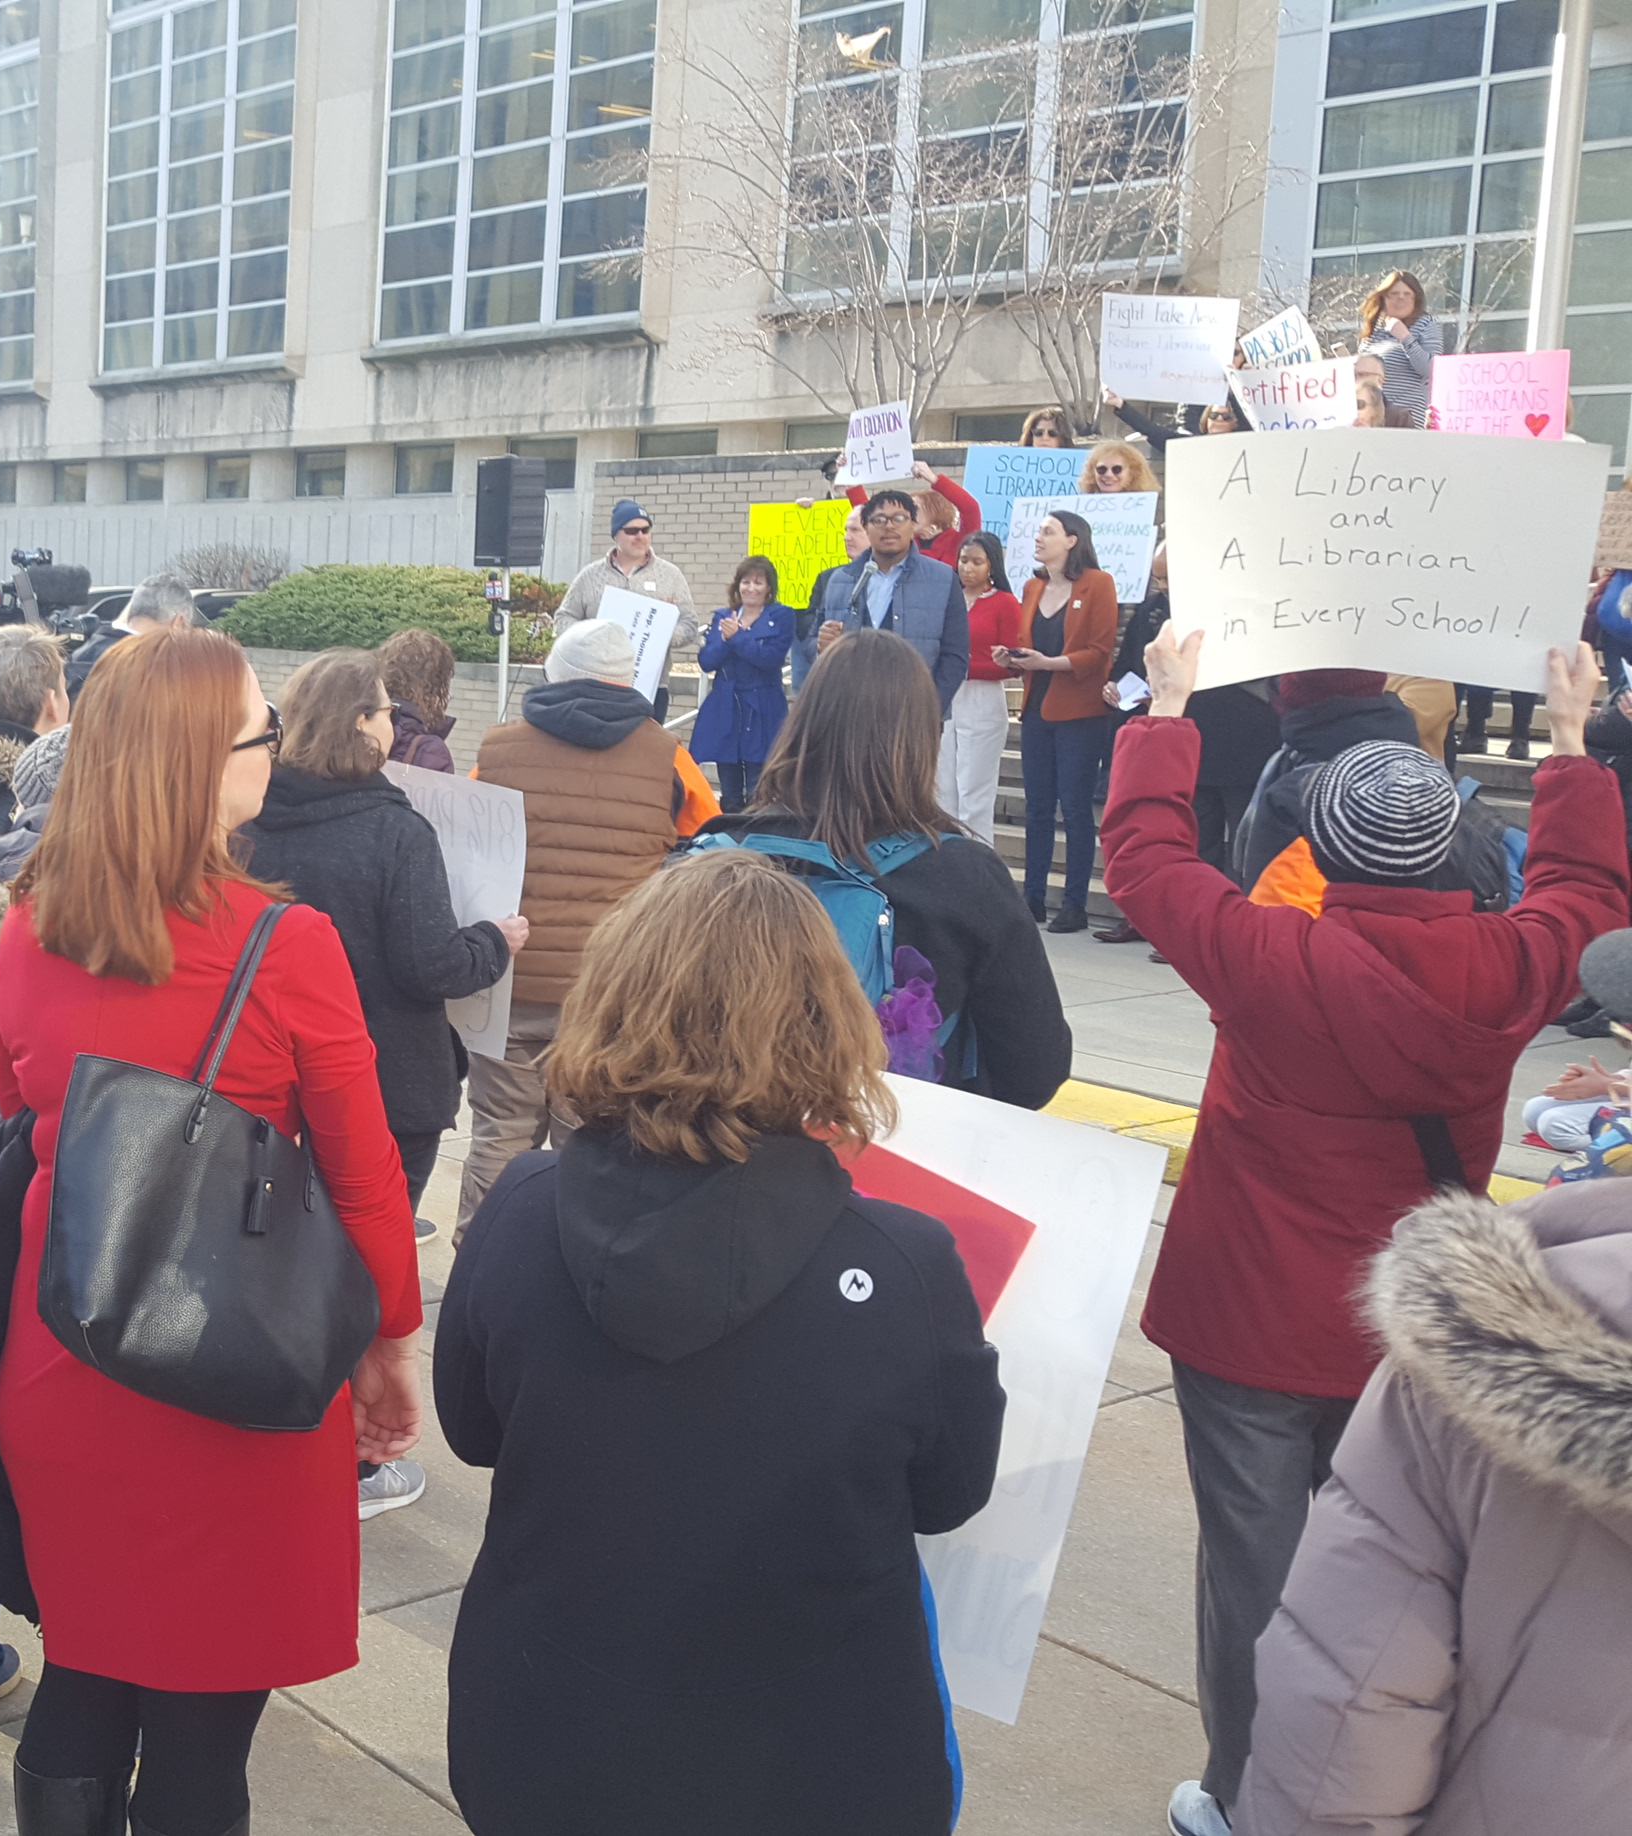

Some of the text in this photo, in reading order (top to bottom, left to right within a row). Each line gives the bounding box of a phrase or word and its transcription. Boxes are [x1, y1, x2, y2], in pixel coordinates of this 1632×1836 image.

[1109, 299, 1144, 328] Fight
[1155, 302, 1185, 324] Fake
[1458, 361, 1540, 385] SCHOOL
[1446, 388, 1549, 412] LIBRARIANS
[994, 454, 1080, 478] SCHOOL
[985, 475, 1079, 497] LIBRARIAN
[1219, 447, 1446, 513] A Library
[783, 505, 850, 533] EVERY
[1021, 499, 1061, 518] THE
[1075, 497, 1116, 514] LOSS
[1123, 497, 1146, 511] OF
[1330, 506, 1393, 529] and
[1092, 523, 1151, 537] BRARIANS
[752, 531, 845, 557] PHILADELP
[1220, 536, 1476, 572] A Librarian
[778, 557, 813, 581] DENT
[1224, 612, 1247, 641] in
[1274, 598, 1365, 635] Every
